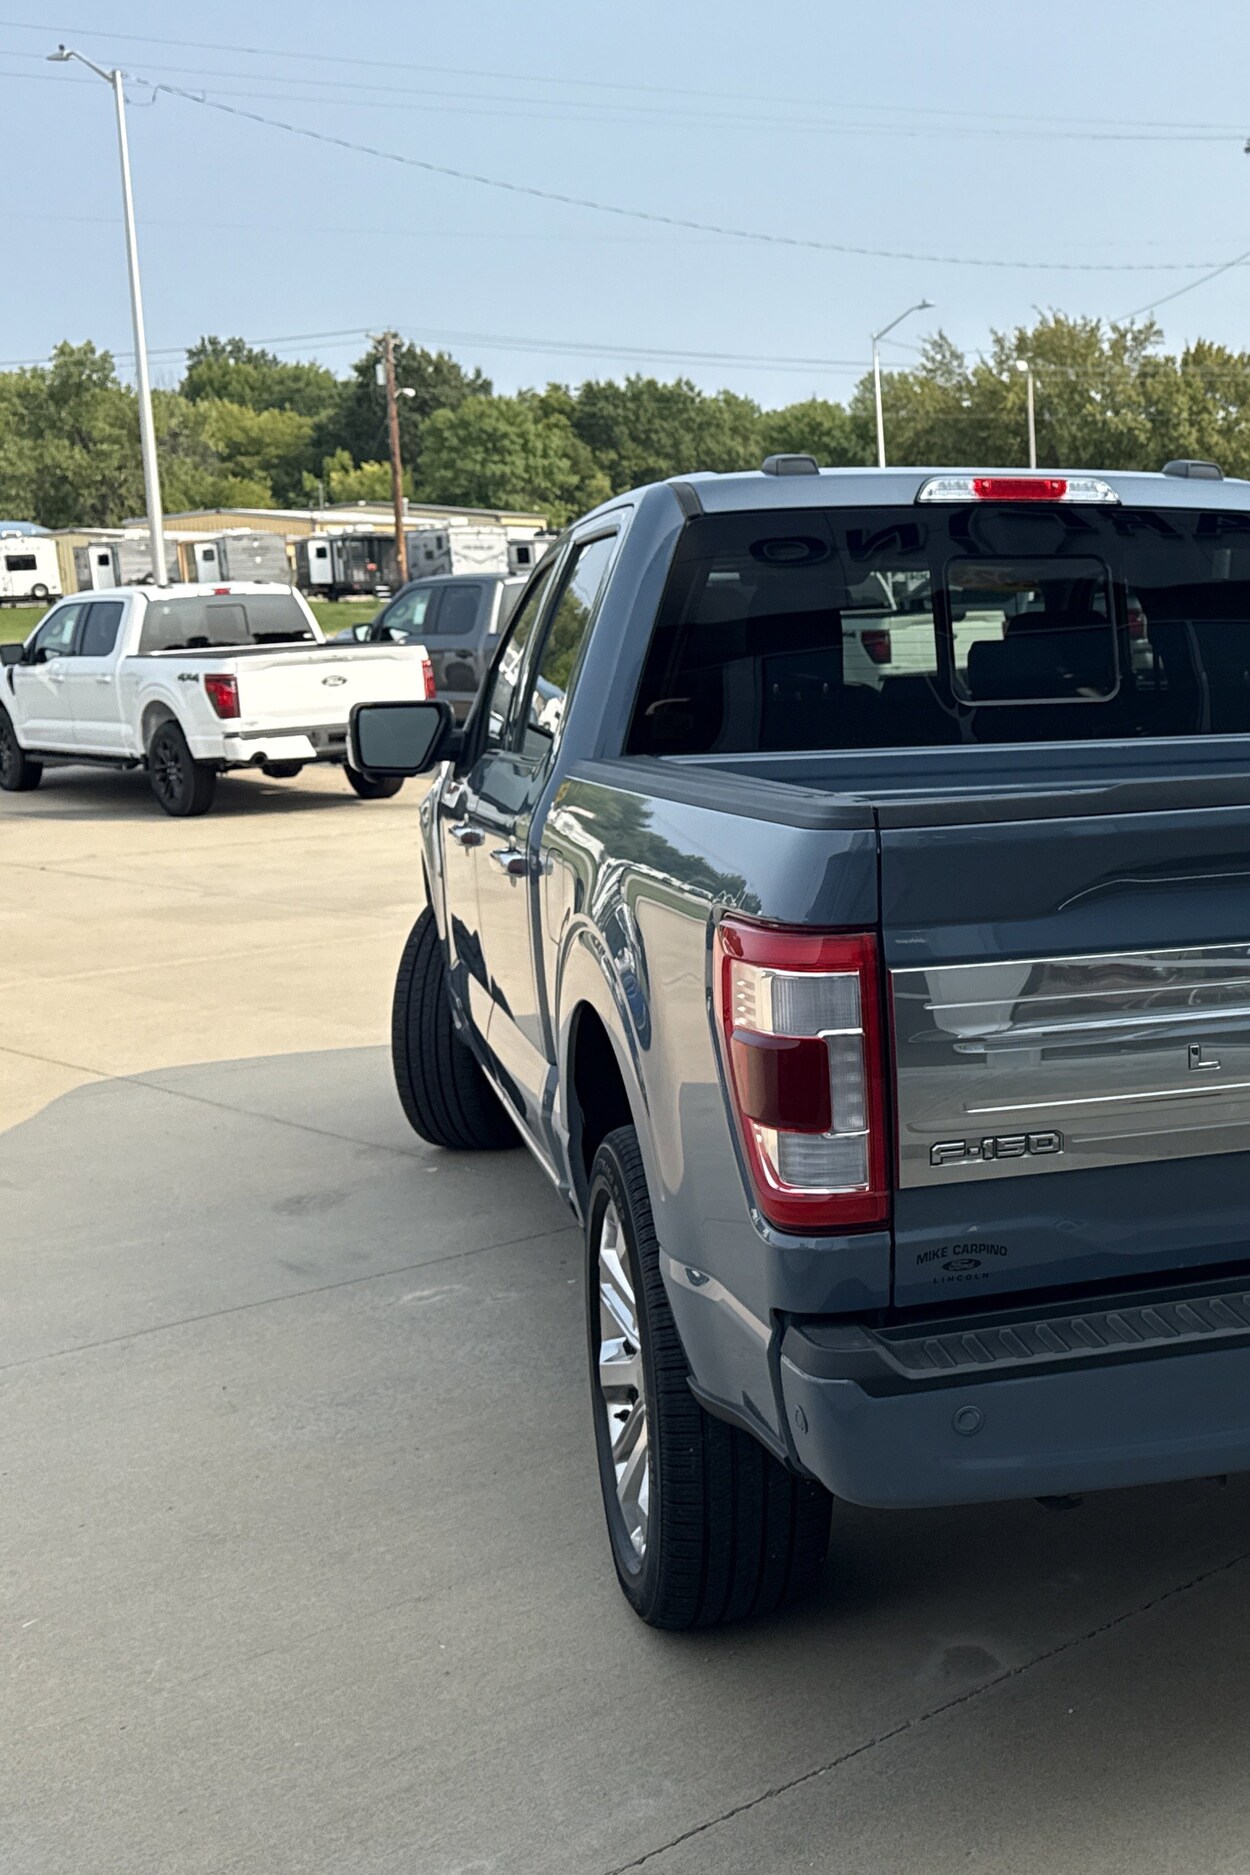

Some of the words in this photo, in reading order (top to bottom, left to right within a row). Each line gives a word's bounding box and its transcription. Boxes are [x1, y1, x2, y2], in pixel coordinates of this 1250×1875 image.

[930, 1129, 1064, 1166] F-150
[916, 1247, 949, 1265] MIKE
[952, 1243, 1008, 1256] CARPINO
[933, 1273, 989, 1284] LINCOLN
